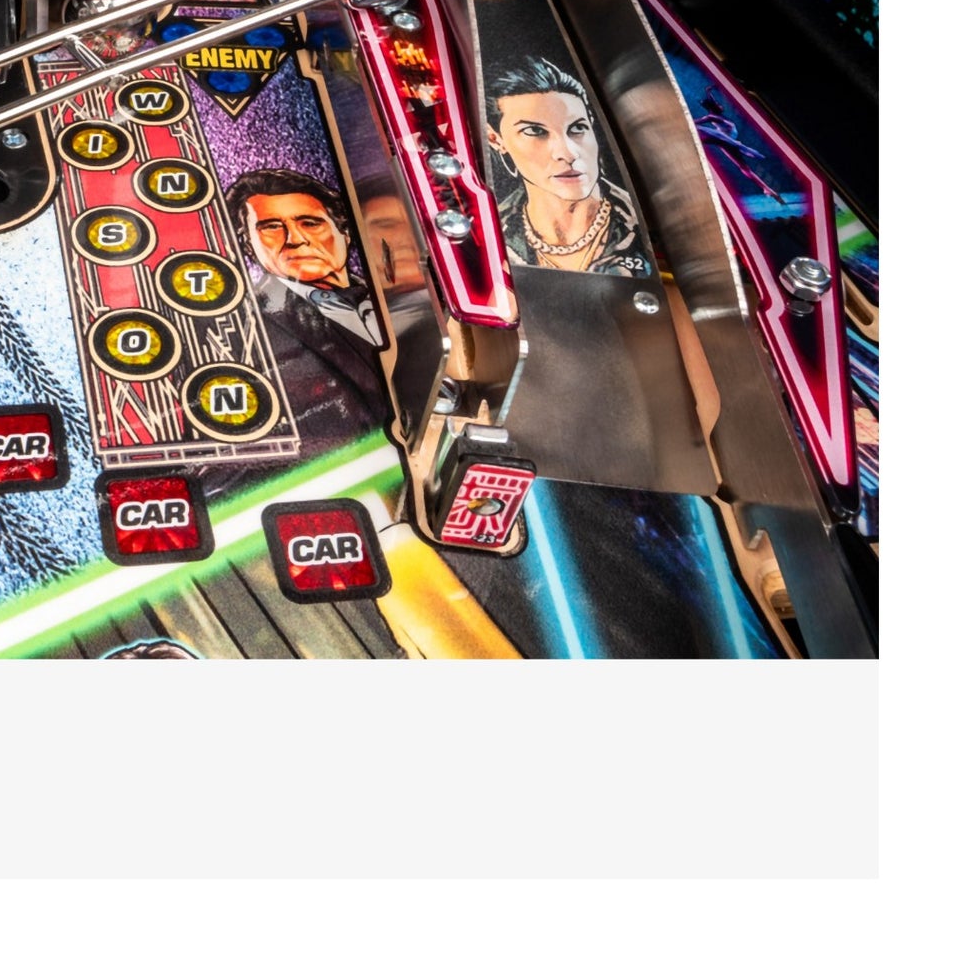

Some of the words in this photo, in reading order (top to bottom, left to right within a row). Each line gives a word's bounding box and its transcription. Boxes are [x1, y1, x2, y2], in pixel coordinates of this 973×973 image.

[185, 47, 274, 70] ENEMY
[620, 257, 644, 270] -52
[119, 500, 187, 527] CAR
[290, 534, 361, 564] CAR
